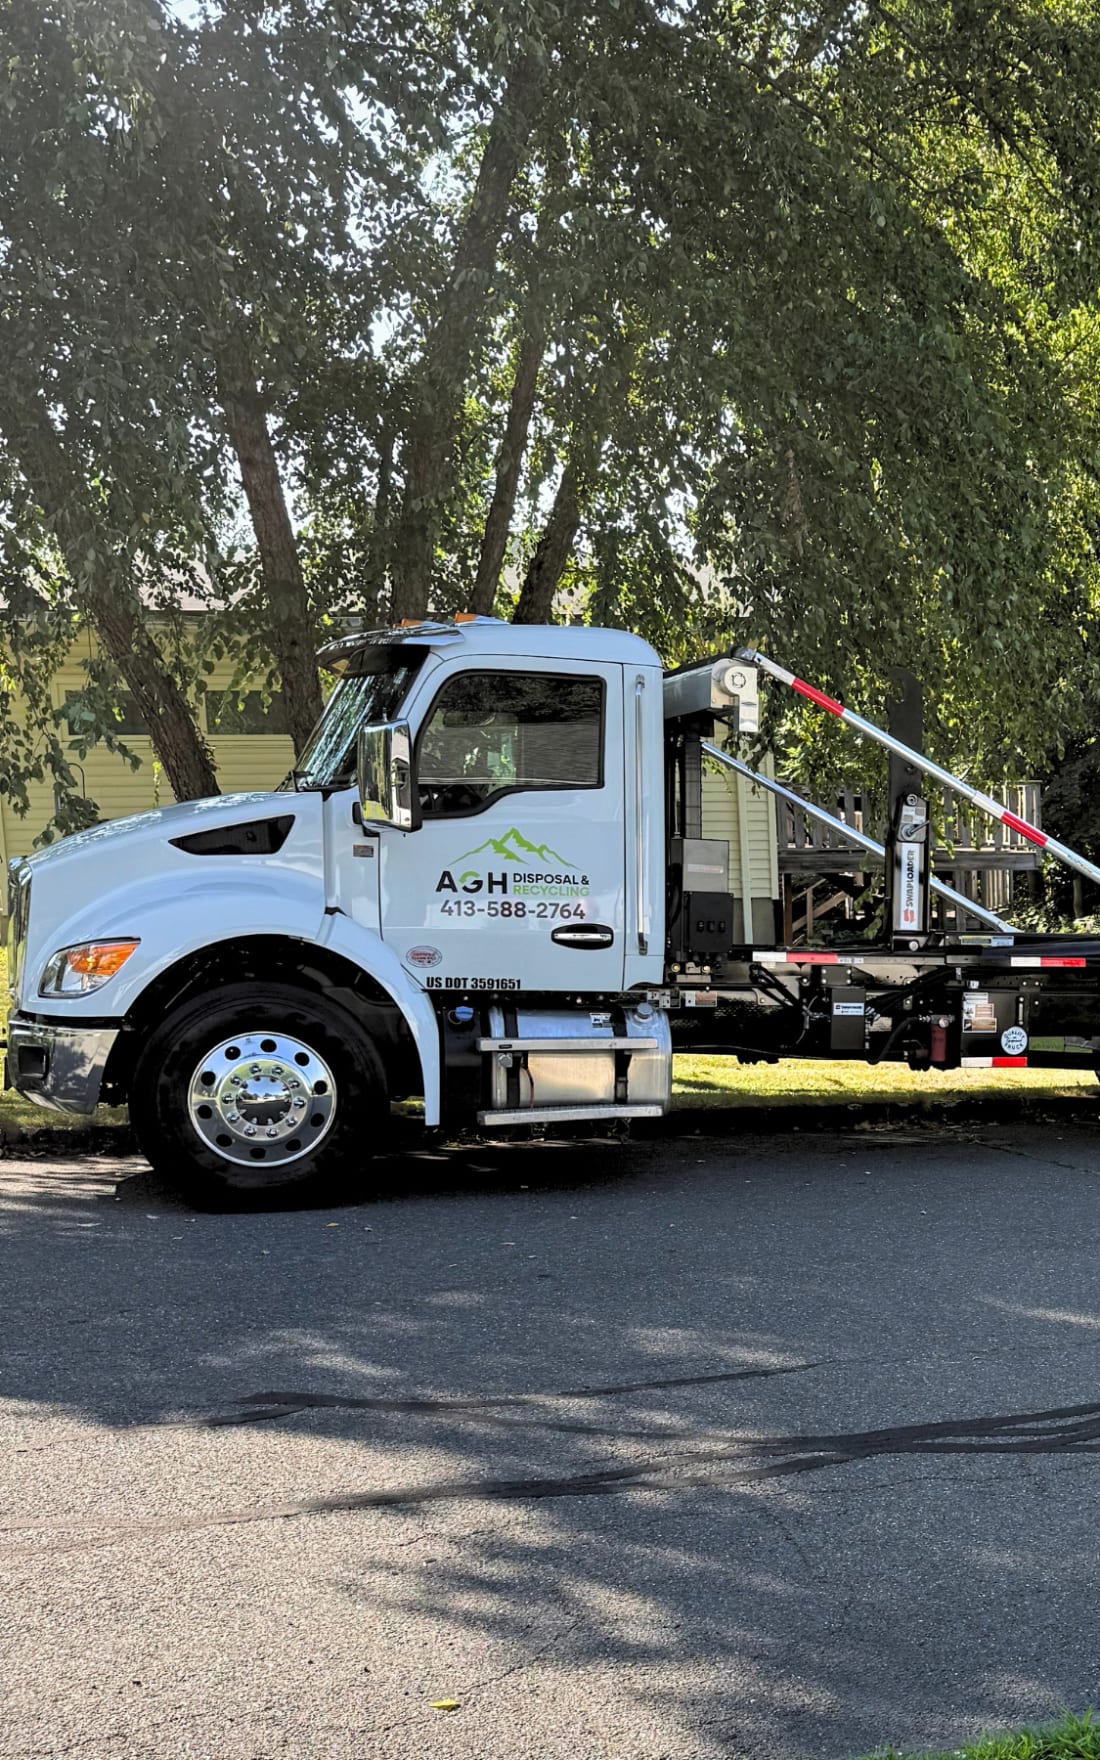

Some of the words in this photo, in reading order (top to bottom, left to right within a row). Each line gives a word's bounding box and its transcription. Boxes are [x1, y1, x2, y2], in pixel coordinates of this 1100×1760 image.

[435, 870, 508, 894] AGH
[513, 873, 579, 885] DISPOSAL
[581, 875, 590, 885] &
[905, 850, 915, 907] SWAPLOADER
[513, 886, 590, 896] RECYCLING
[440, 900, 586, 919] 413-588-2764
[426, 976, 442, 988] US
[445, 977, 470, 989] DOT
[471, 978, 521, 990] 3591651
